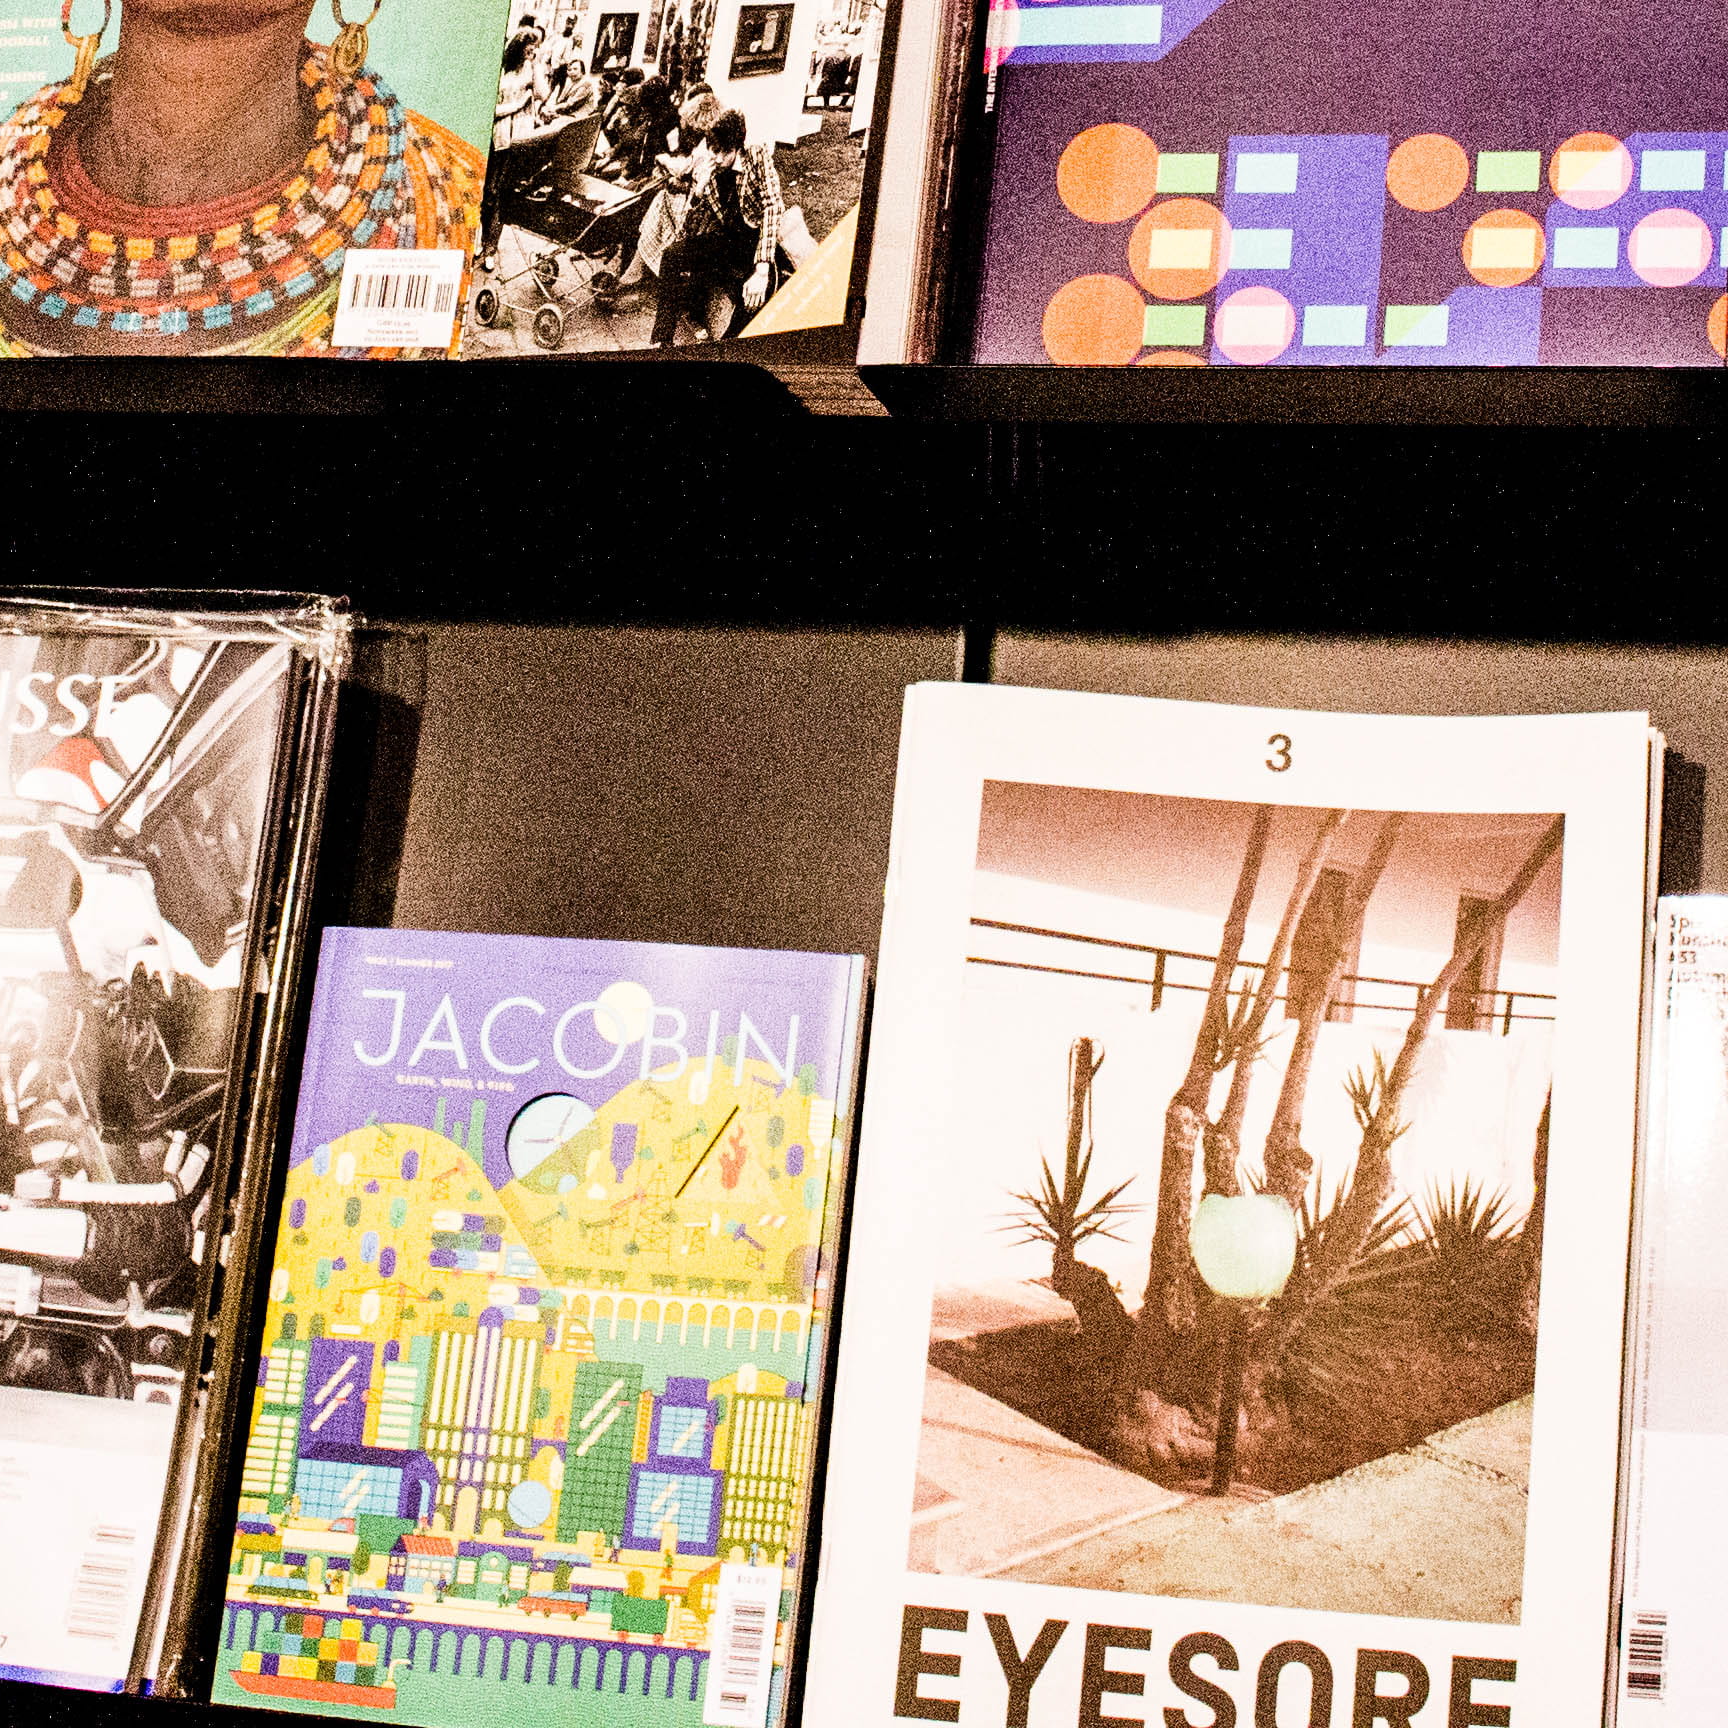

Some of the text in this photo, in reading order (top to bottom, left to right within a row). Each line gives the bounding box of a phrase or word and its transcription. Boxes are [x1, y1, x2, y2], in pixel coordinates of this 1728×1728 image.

[1264, 734, 1292, 774] 3
[353, 988, 801, 1089] JACOBIN
[892, 1603, 1519, 1728] EYESORE
